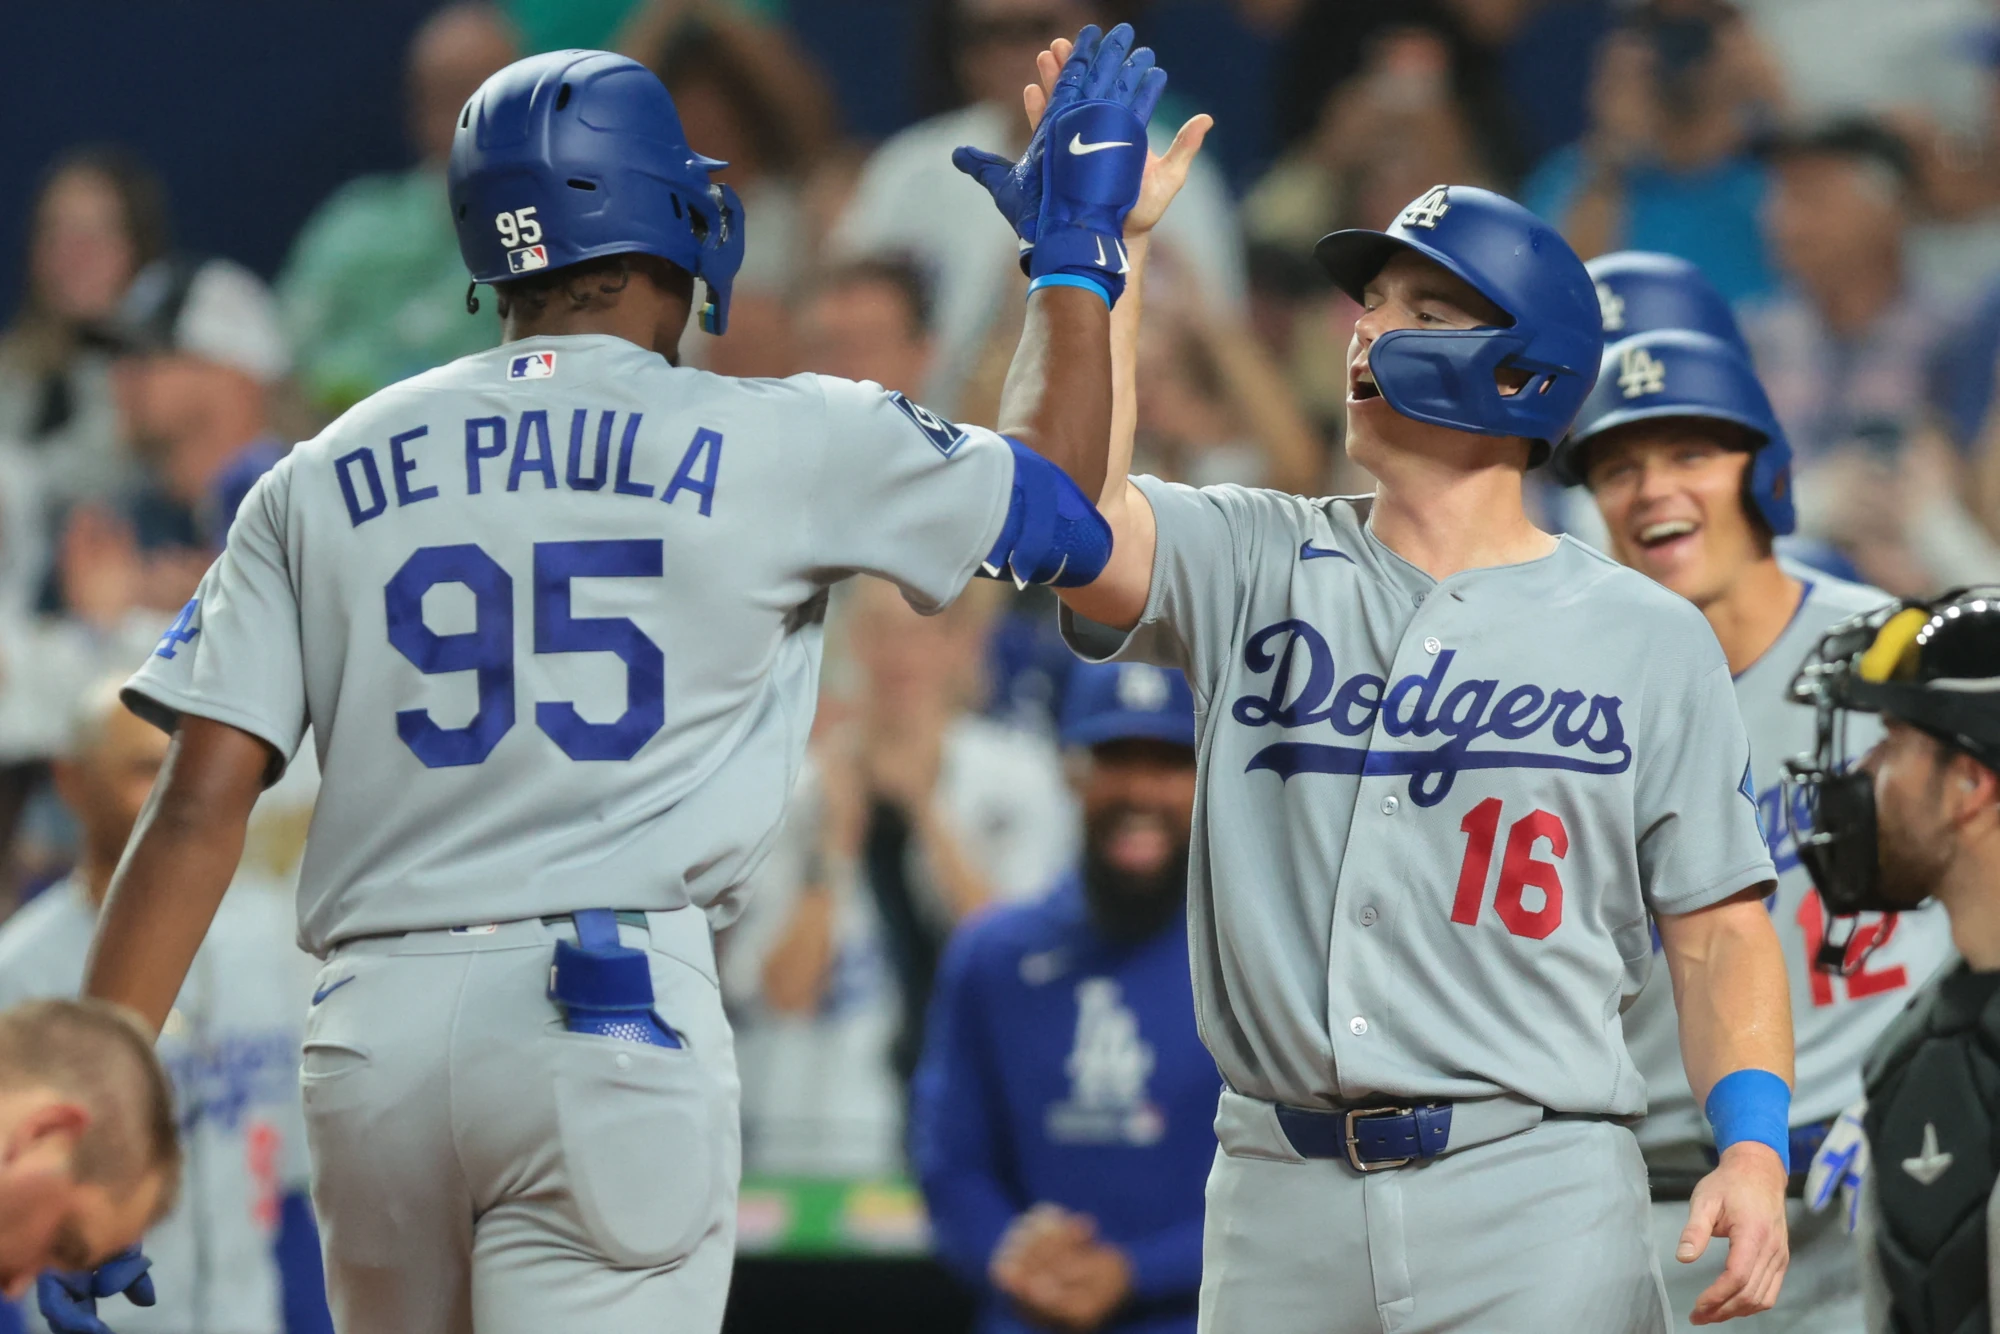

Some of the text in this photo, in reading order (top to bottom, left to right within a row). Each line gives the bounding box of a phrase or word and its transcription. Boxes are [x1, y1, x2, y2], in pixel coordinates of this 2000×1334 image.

[495, 206, 542, 248] 95
[1401, 184, 1450, 229] LA
[1617, 346, 1665, 399] LA
[334, 408, 724, 529] DE PAULA
[384, 538, 665, 769] 95
[1232, 618, 1632, 808] Dodgers
[1451, 796, 1569, 941] 16
[1796, 886, 1907, 1007] 12
